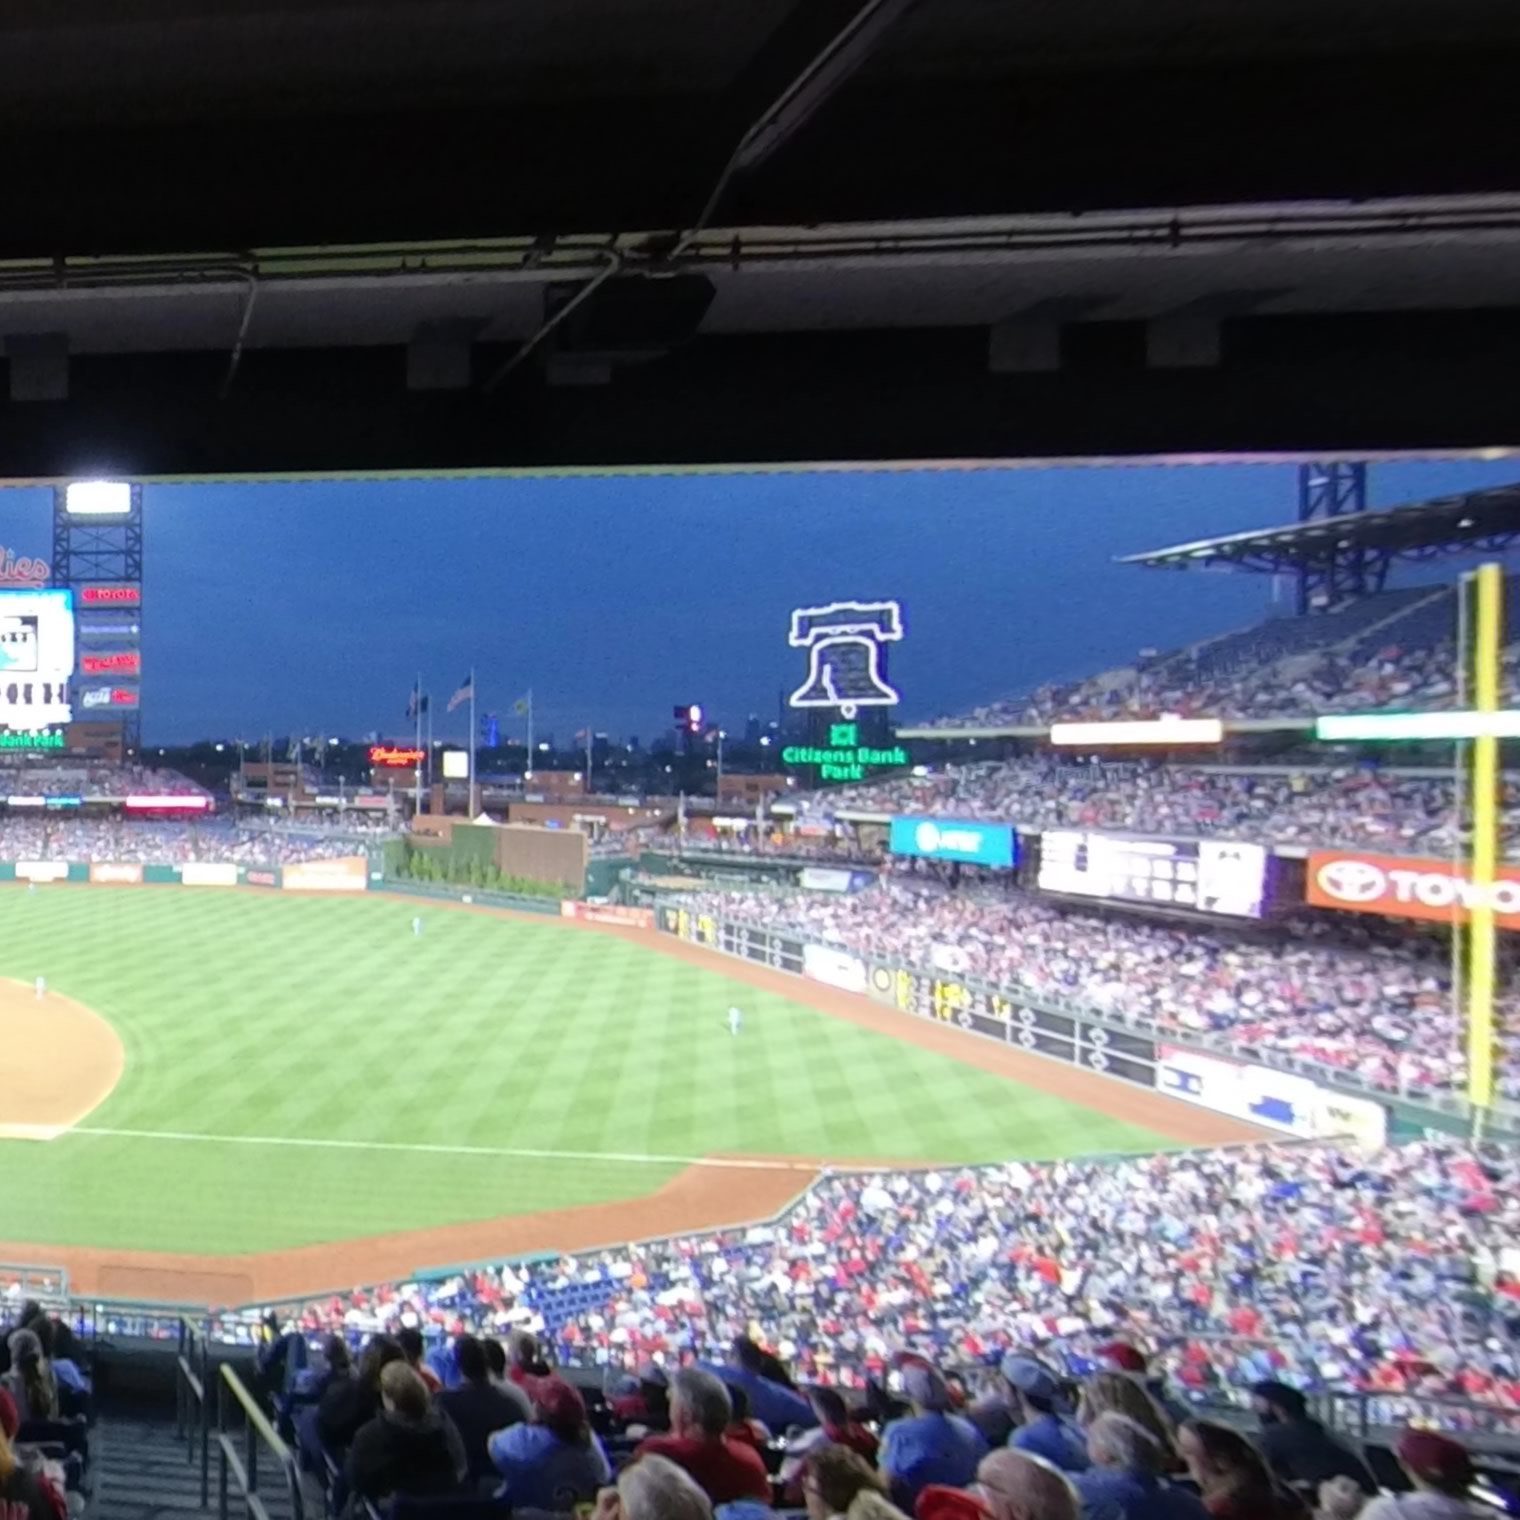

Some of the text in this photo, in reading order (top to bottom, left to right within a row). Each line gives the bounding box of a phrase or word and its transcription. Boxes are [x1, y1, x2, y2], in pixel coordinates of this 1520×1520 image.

[0, 733, 31, 747] Bank
[33, 733, 64, 747] Park
[783, 746, 906, 764] Citizens Bank
[821, 763, 864, 779] Park
